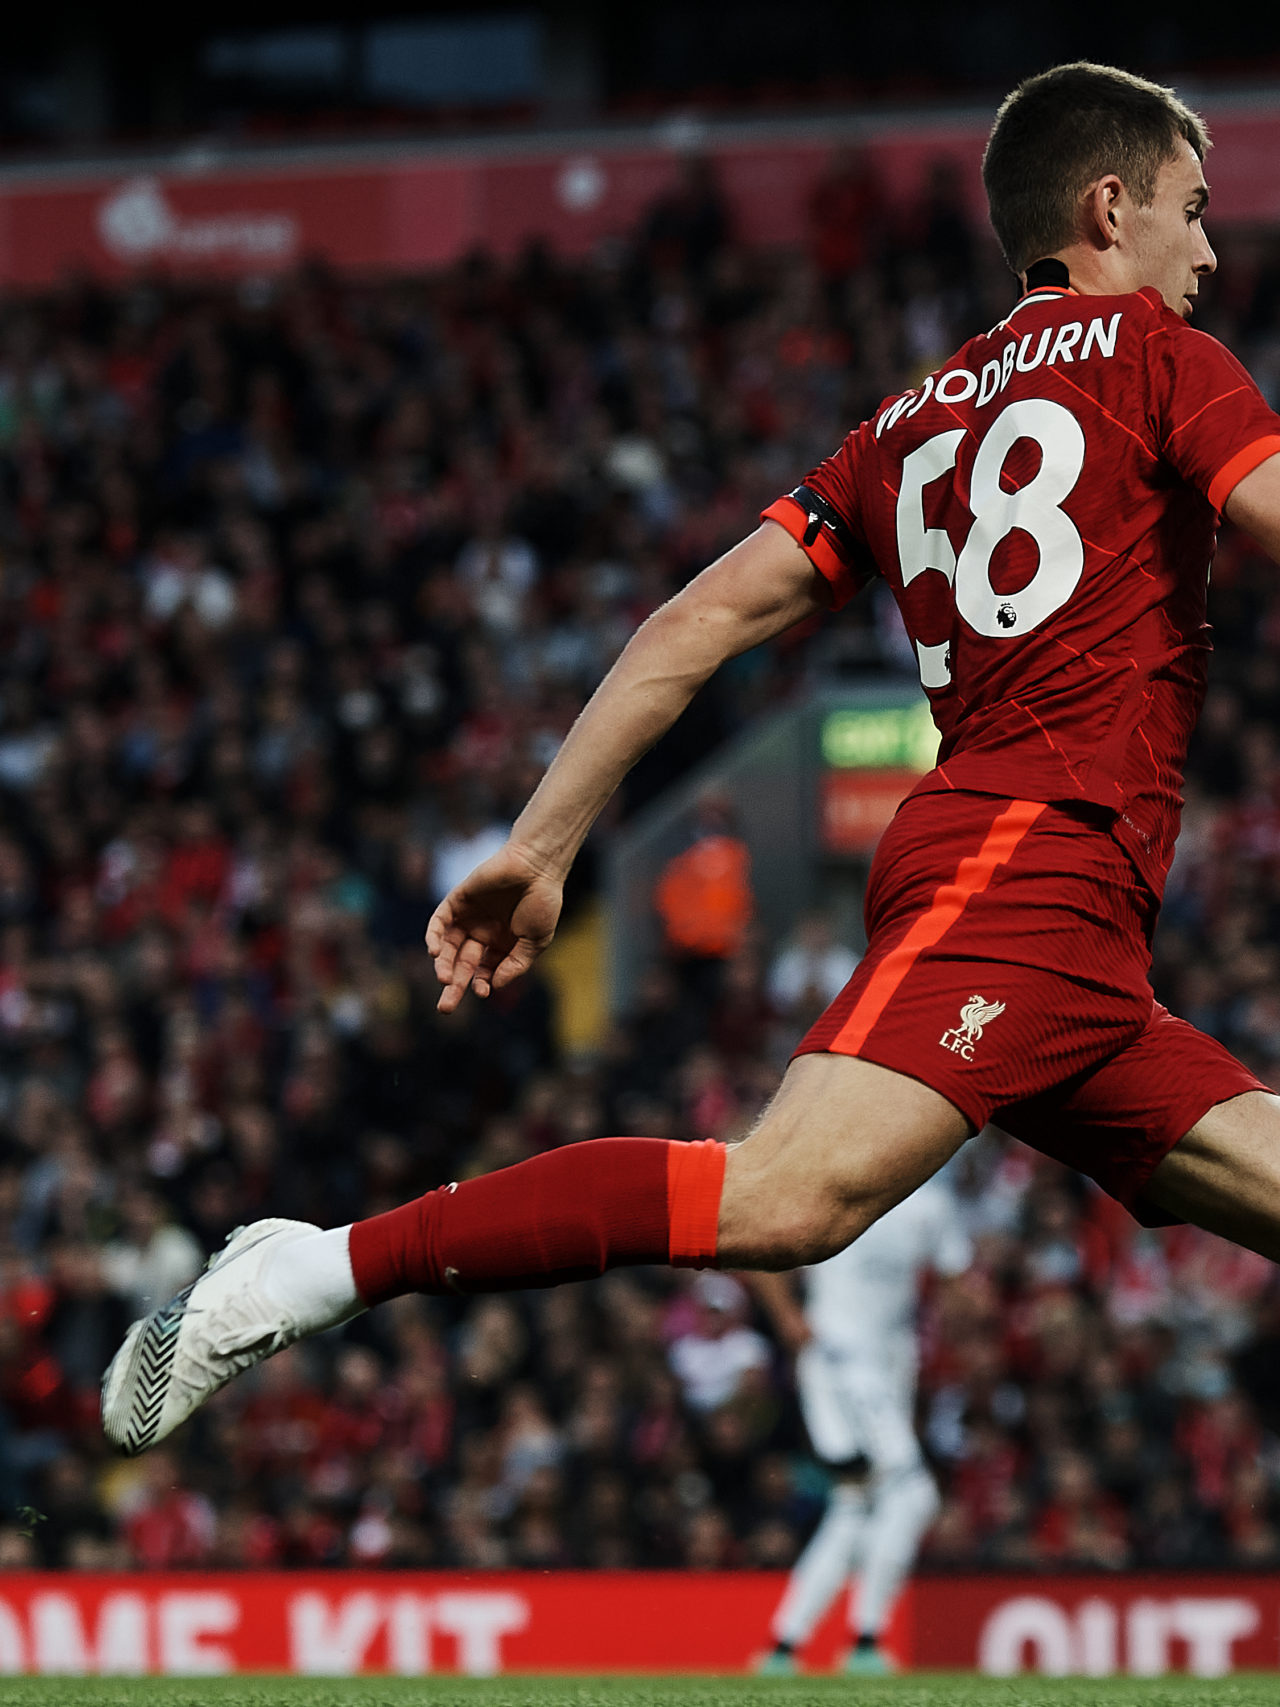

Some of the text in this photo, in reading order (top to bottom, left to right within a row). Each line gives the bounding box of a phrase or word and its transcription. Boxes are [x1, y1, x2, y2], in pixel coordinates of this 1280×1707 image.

[896, 399, 1086, 689] 58
[287, 1589, 531, 1677] KIT
[977, 1595, 1260, 1678] OUT
